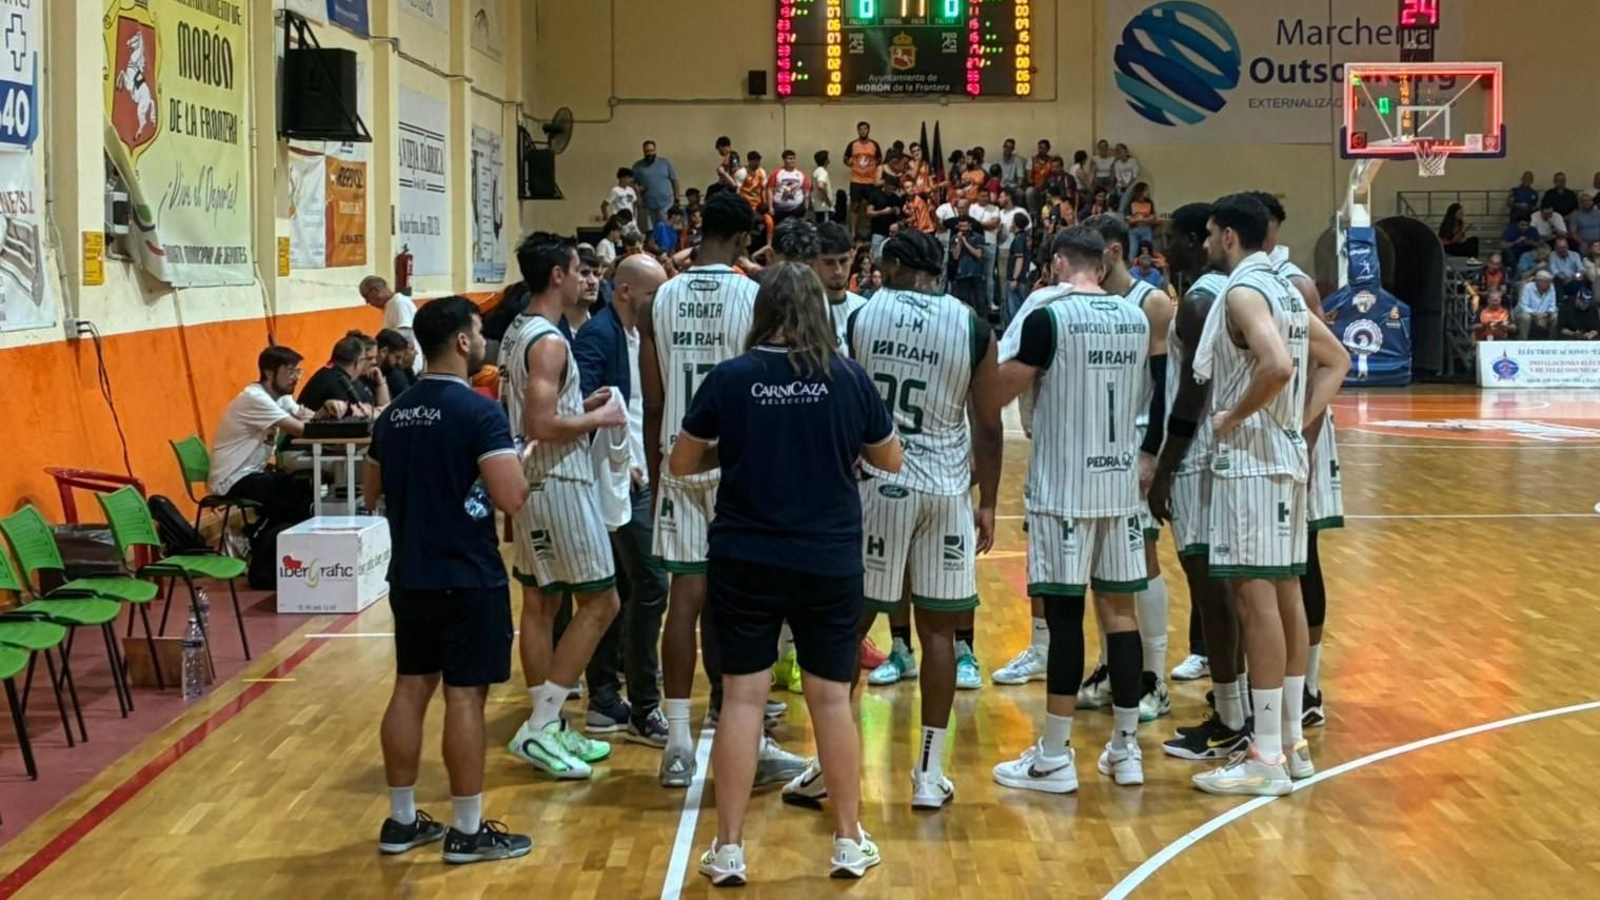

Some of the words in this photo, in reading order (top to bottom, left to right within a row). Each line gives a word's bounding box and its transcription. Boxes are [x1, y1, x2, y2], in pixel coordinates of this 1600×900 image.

[1402, 0, 1436, 24] 24
[178, 20, 235, 90] MORÓN
[868, 74, 925, 83] Ayuntamiento
[926, 74, 938, 82] de
[856, 83, 890, 92] MORÓN
[893, 84, 903, 92] de
[905, 84, 914, 92] la
[915, 84, 951, 92] Frontera
[1248, 97, 1366, 109] EXTERNALIZACN
[170, 98, 182, 134] DE
[186, 101, 197, 138] LA
[200, 106, 239, 146] FRONTERA
[679, 302, 722, 319] SAGNIA
[895, 314, 923, 333] J-M
[695, 332, 725, 347] RAHI
[896, 343, 939, 366] RAHI
[1105, 350, 1137, 365] RAHI
[1107, 381, 1115, 443] 1
[1087, 456, 1120, 468] PEDRA
